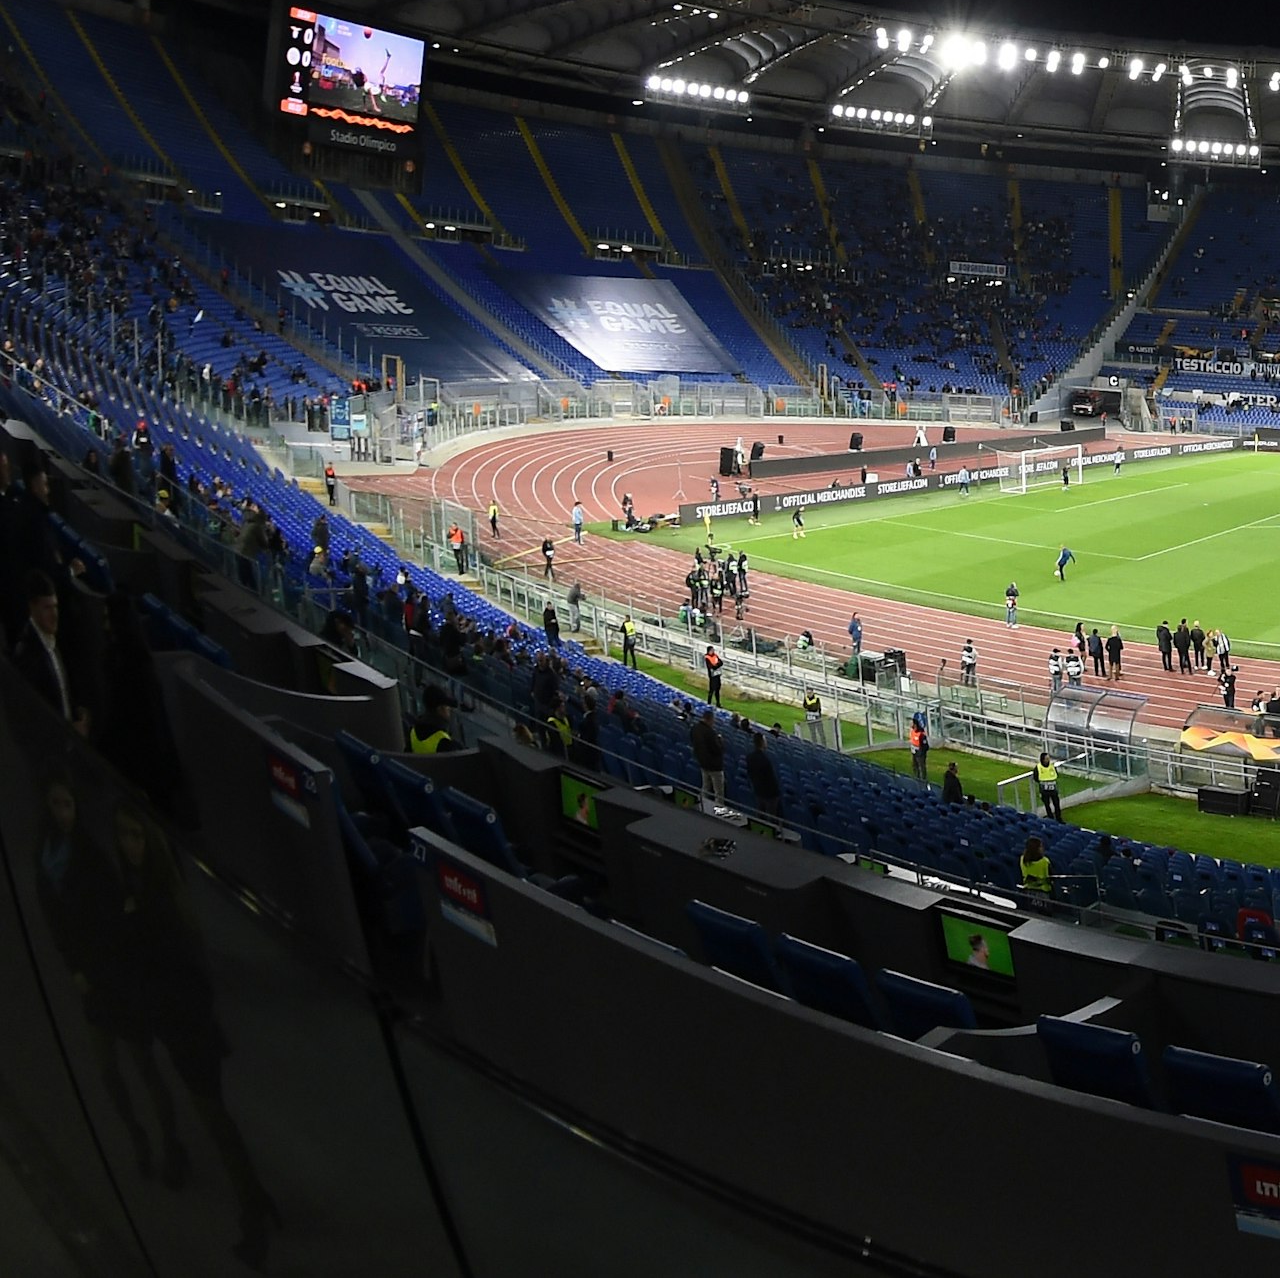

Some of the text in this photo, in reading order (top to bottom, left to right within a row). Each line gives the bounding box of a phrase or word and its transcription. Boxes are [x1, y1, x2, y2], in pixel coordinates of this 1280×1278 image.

[330, 129, 396, 152] Stadio Olimpico
[332, 291, 414, 315] GAME
[599, 316, 687, 334] GAME
[1175, 358, 1242, 374] TESTACCIO
[1109, 375, 1119, 387] C
[783, 486, 866, 508] OFFICIAL MERCHANDISE
[411, 840, 427, 862] 27
